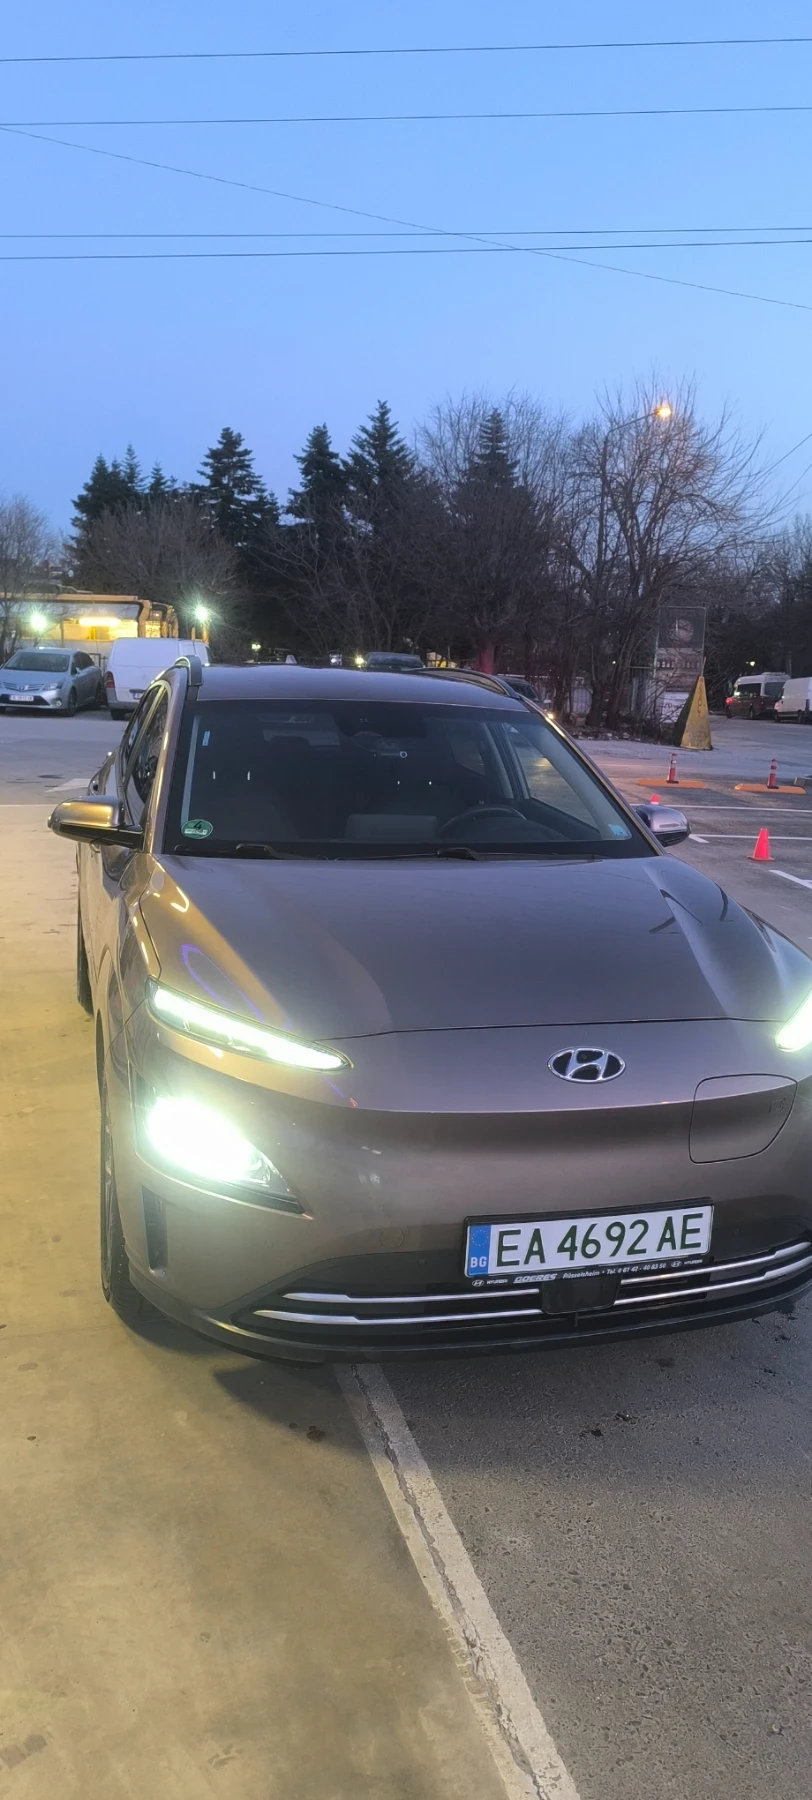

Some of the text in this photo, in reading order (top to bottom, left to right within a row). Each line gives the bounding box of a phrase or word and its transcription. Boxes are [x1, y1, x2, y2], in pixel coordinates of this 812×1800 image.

[496, 1213, 704, 1268] EA 4692 AE
[470, 1256, 487, 1268] BG
[513, 1273, 558, 1284] GOERES
[562, 1270, 600, 1280] Rüsselsheim
